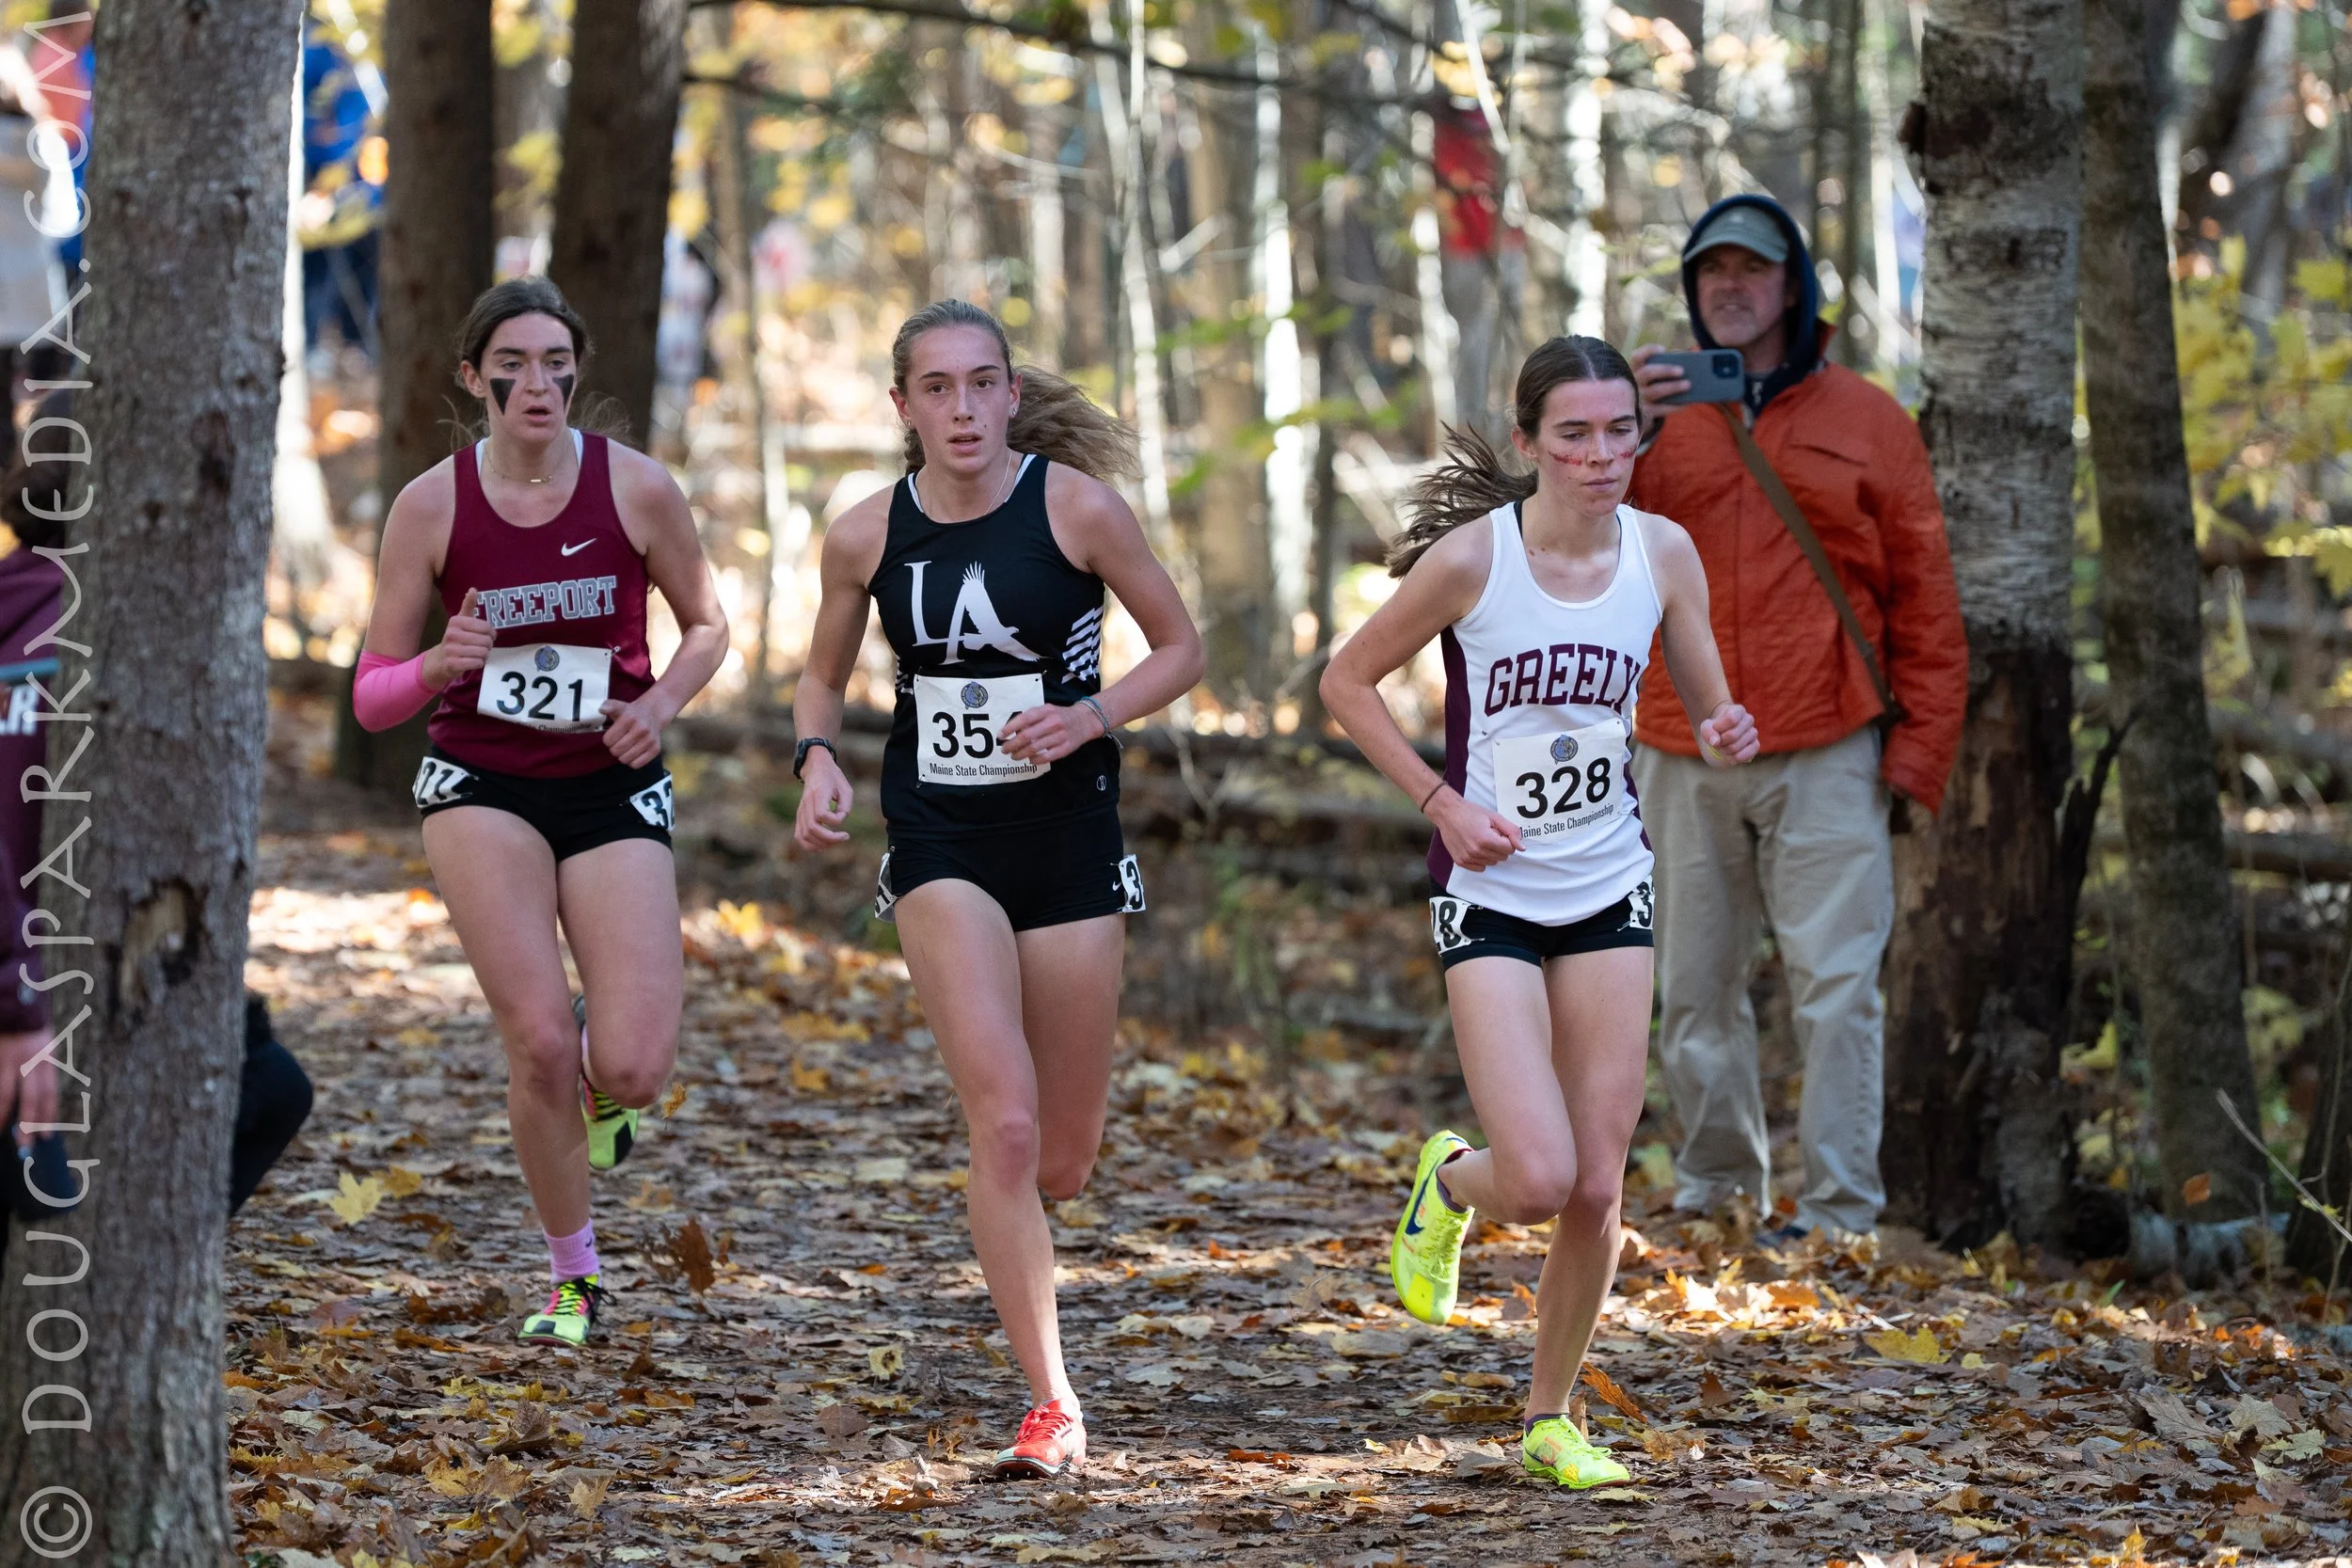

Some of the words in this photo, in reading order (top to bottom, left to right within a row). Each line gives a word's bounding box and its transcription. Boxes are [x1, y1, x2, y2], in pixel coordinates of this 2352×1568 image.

[904, 561, 1043, 665] LA
[496, 671, 584, 722] 321
[1484, 642, 1642, 718] GREELY
[414, 761, 454, 805] 21
[930, 763, 953, 776] Maine
[955, 764, 977, 777] State
[978, 763, 1038, 778] Championship
[1515, 757, 1612, 819] 328
[1543, 822, 1565, 834] State
[1566, 802, 1614, 830] Championship
